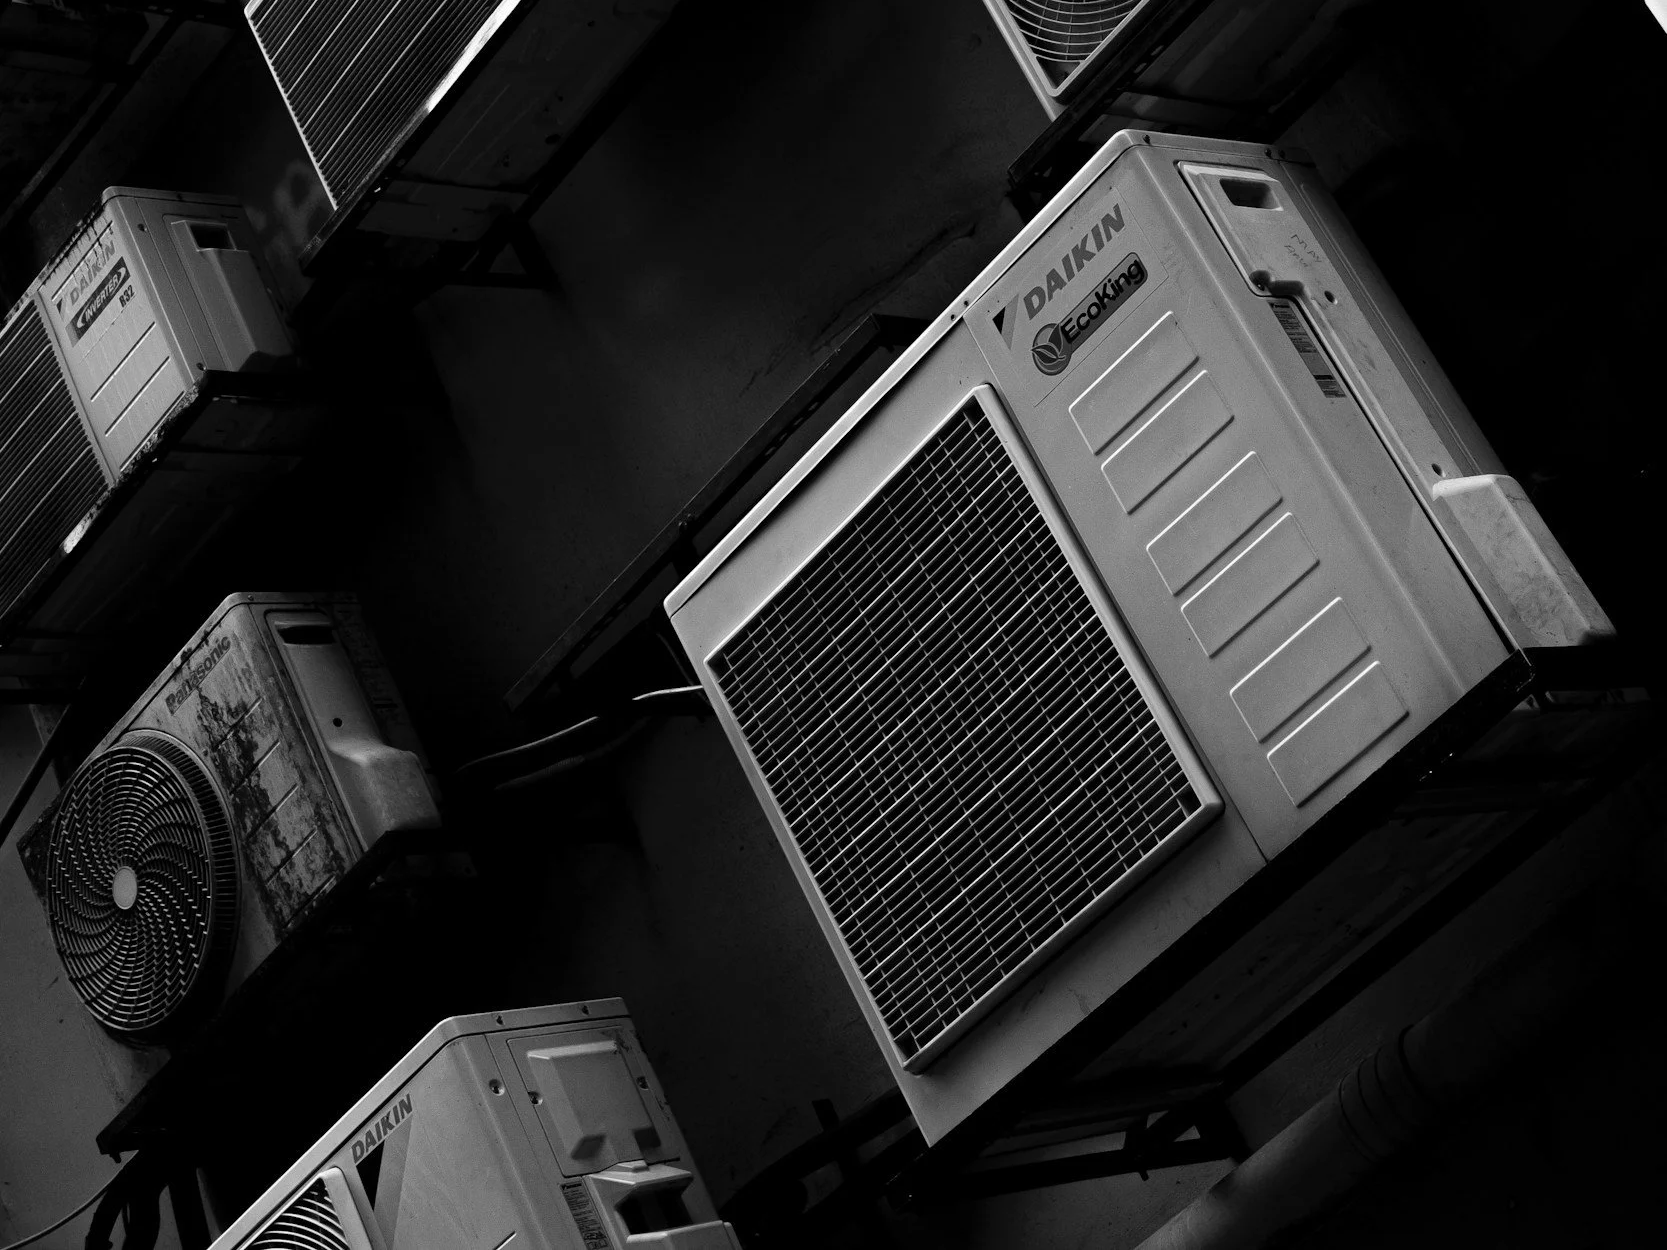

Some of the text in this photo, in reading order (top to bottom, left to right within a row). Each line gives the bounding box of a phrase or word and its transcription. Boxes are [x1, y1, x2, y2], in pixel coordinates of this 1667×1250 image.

[69, 240, 116, 306] DAIKIN
[118, 284, 136, 308] R32
[1023, 202, 1125, 321] DAIKIN
[83, 273, 120, 323] INVERTER
[1060, 259, 1145, 344] EcoKing
[165, 636, 232, 716] Panasonic
[351, 1092, 413, 1164] DAIKIN
